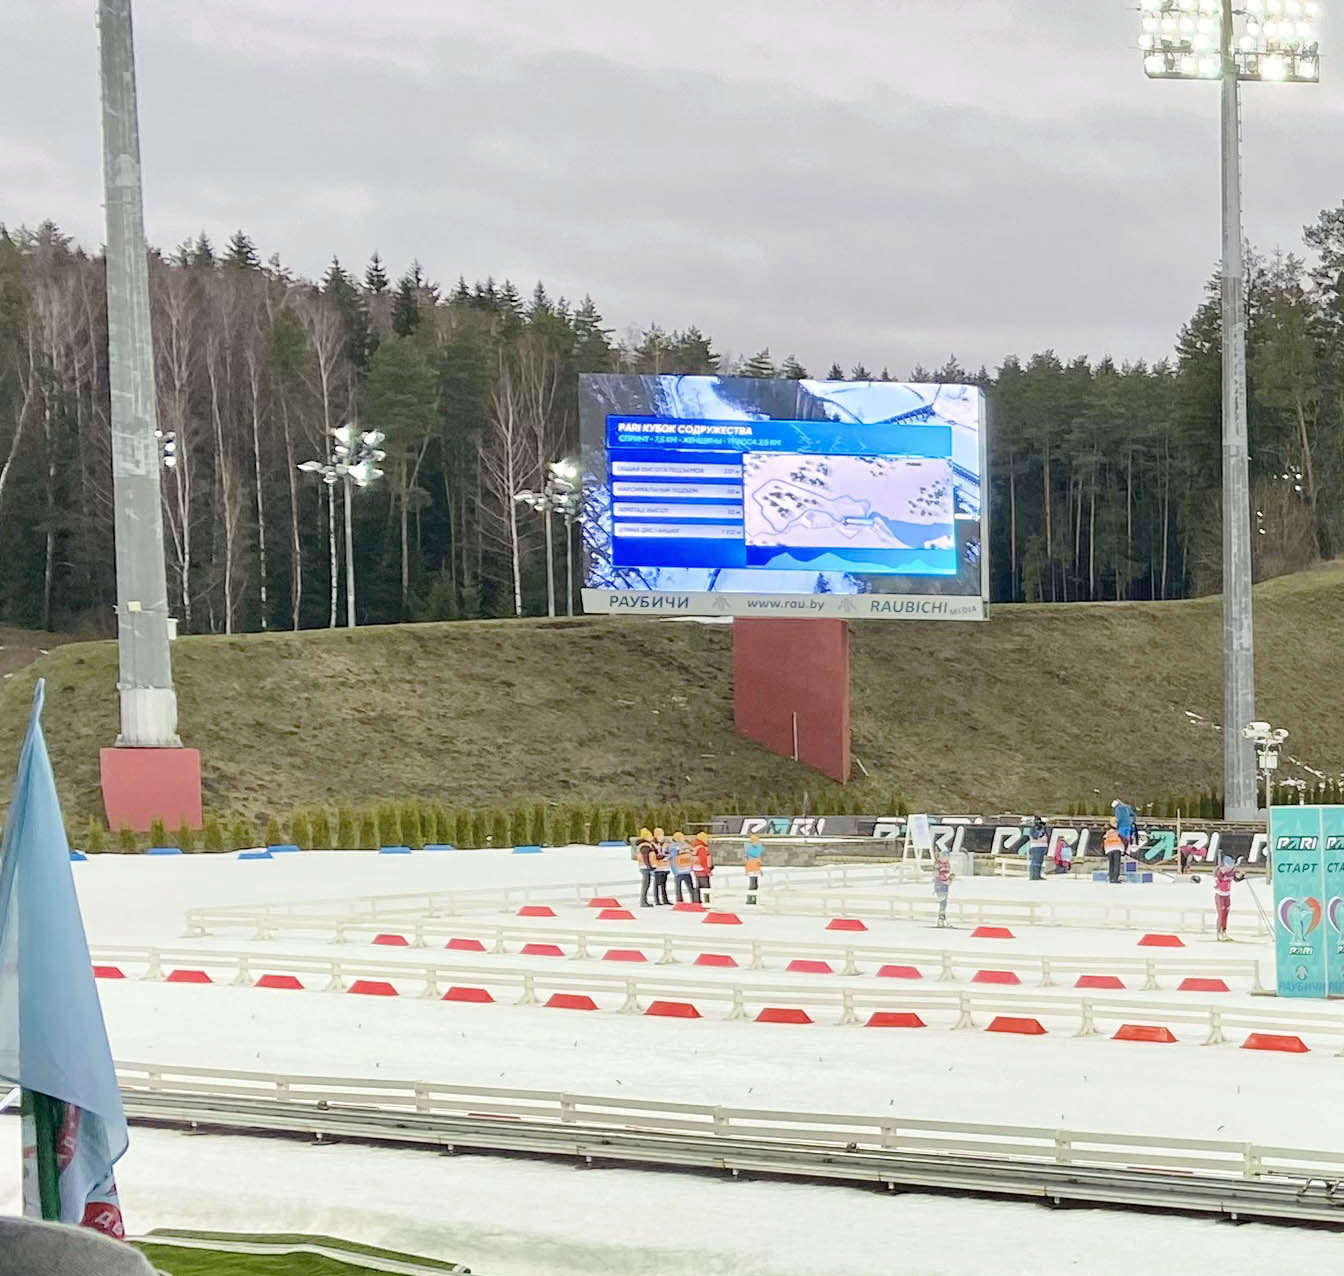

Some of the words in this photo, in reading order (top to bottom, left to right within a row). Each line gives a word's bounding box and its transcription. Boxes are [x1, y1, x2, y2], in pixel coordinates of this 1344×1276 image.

[618, 423, 640, 433] PARI
[643, 424, 675, 434] КУБОК
[677, 424, 752, 436] СОДРУЖЕСТВА
[609, 595, 689, 610] РАУБИЧИ
[747, 598, 825, 612] www.rau.by
[869, 600, 948, 615] RAUBICHI
[1277, 837, 1317, 850] PARI
[1278, 863, 1318, 873] СТАРТ
